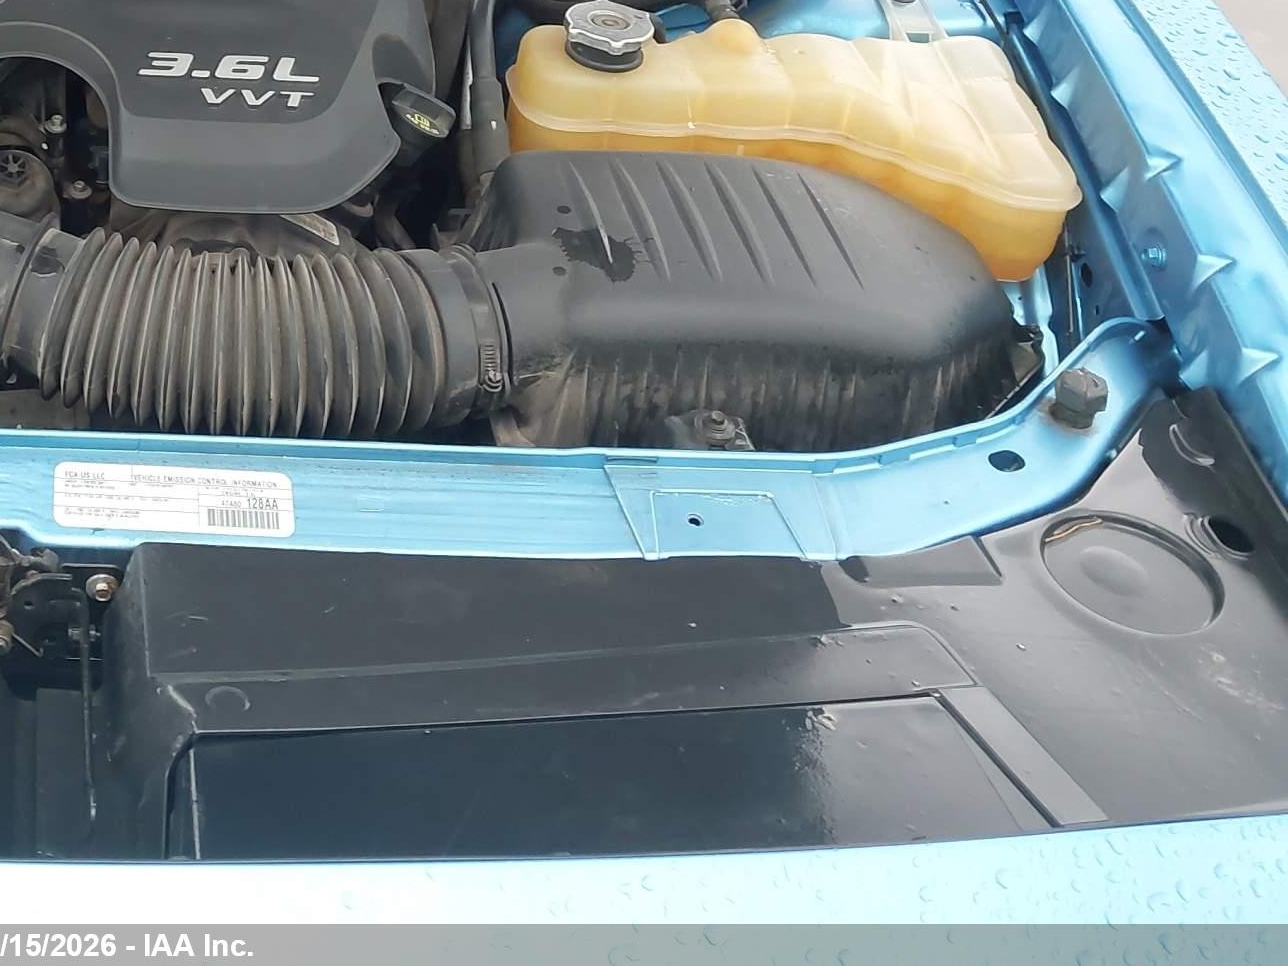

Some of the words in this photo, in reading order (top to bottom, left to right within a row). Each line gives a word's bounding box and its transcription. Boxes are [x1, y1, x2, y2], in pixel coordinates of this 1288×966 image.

[138, 52, 320, 82] 3.6L
[201, 87, 314, 107] VVT
[64, 470, 79, 478] FCA
[134, 474, 161, 483] VEHICLE
[163, 475, 196, 484] EMISSION
[197, 477, 227, 486] CONTROL
[231, 479, 277, 488] INFORMATION
[247, 498, 279, 510] 128AA
